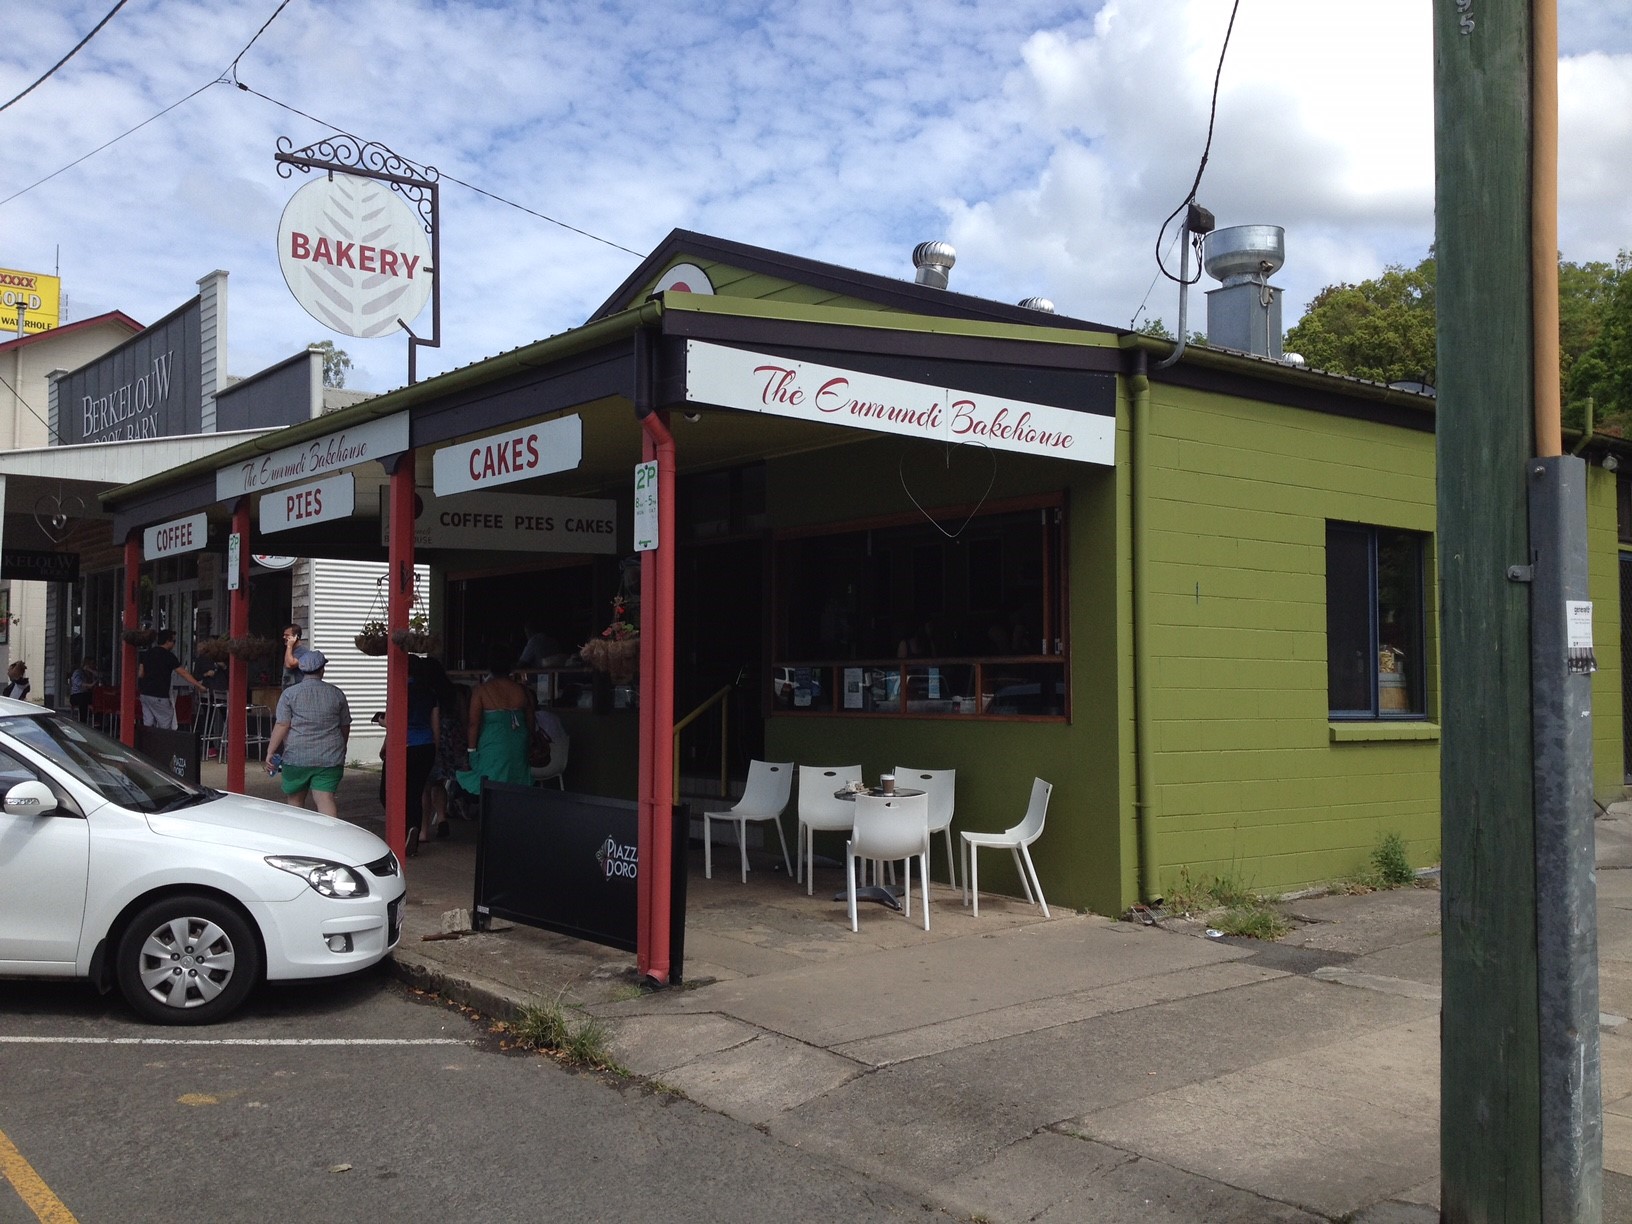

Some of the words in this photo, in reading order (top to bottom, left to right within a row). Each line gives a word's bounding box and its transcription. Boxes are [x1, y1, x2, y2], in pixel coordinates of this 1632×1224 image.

[291, 231, 420, 280] BAKERY
[0, 290, 41, 310] OLD
[1, 316, 52, 330] WATRHOLE
[82, 350, 174, 438] BERKELOUW
[753, 365, 806, 406] The
[815, 377, 943, 431] Eumundi
[951, 399, 1076, 450] Bakehouse
[242, 462, 257, 491] The
[260, 453, 306, 485] Eumundi
[309, 435, 368, 473] Bakehouse
[469, 434, 540, 481] CAKES
[636, 466, 656, 490] 2P
[286, 488, 322, 521] PIES
[440, 511, 504, 529] COFFEE
[514, 515, 555, 531] PIES
[565, 518, 615, 535] CAKES
[156, 522, 193, 552] COFFEE
[229, 537, 239, 551] 2P
[606, 838, 639, 862] PIAZZ
[606, 859, 637, 879] DORO
